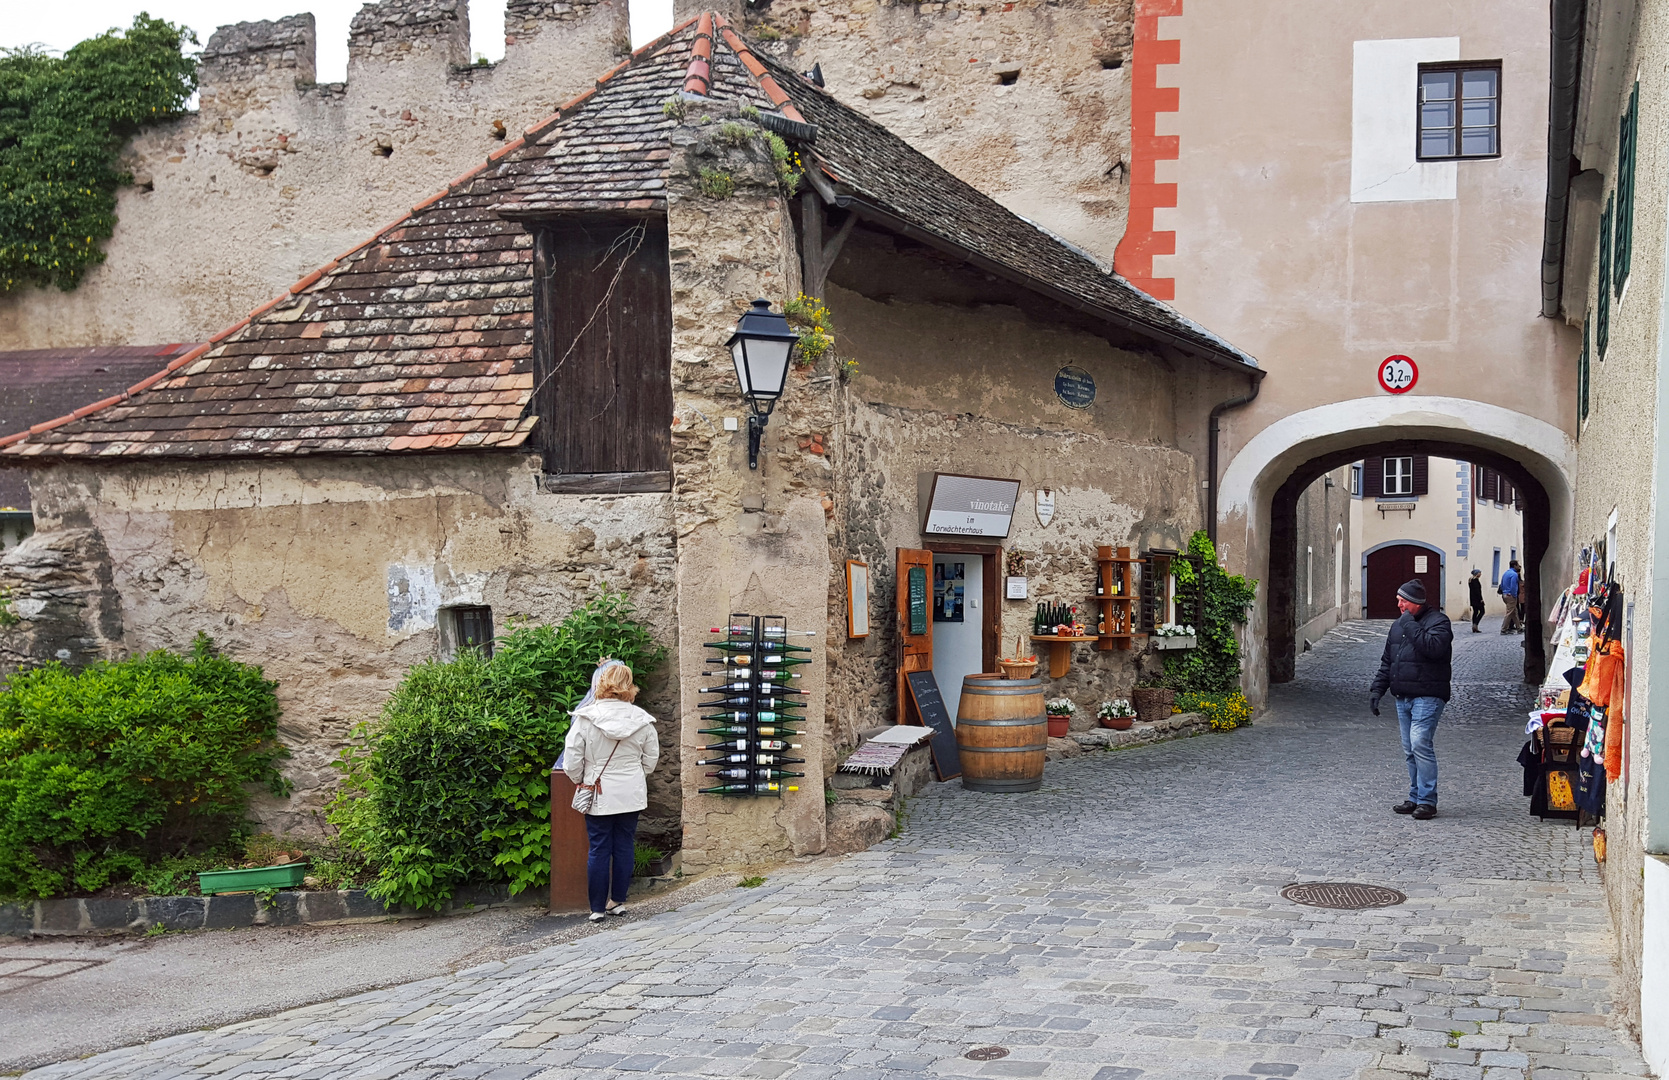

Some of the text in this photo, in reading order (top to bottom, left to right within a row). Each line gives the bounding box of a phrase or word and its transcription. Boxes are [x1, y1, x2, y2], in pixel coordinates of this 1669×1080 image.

[970, 498, 1009, 512] vinotake
[966, 515, 975, 524] im
[932, 524, 983, 534] Torwächterhaus
